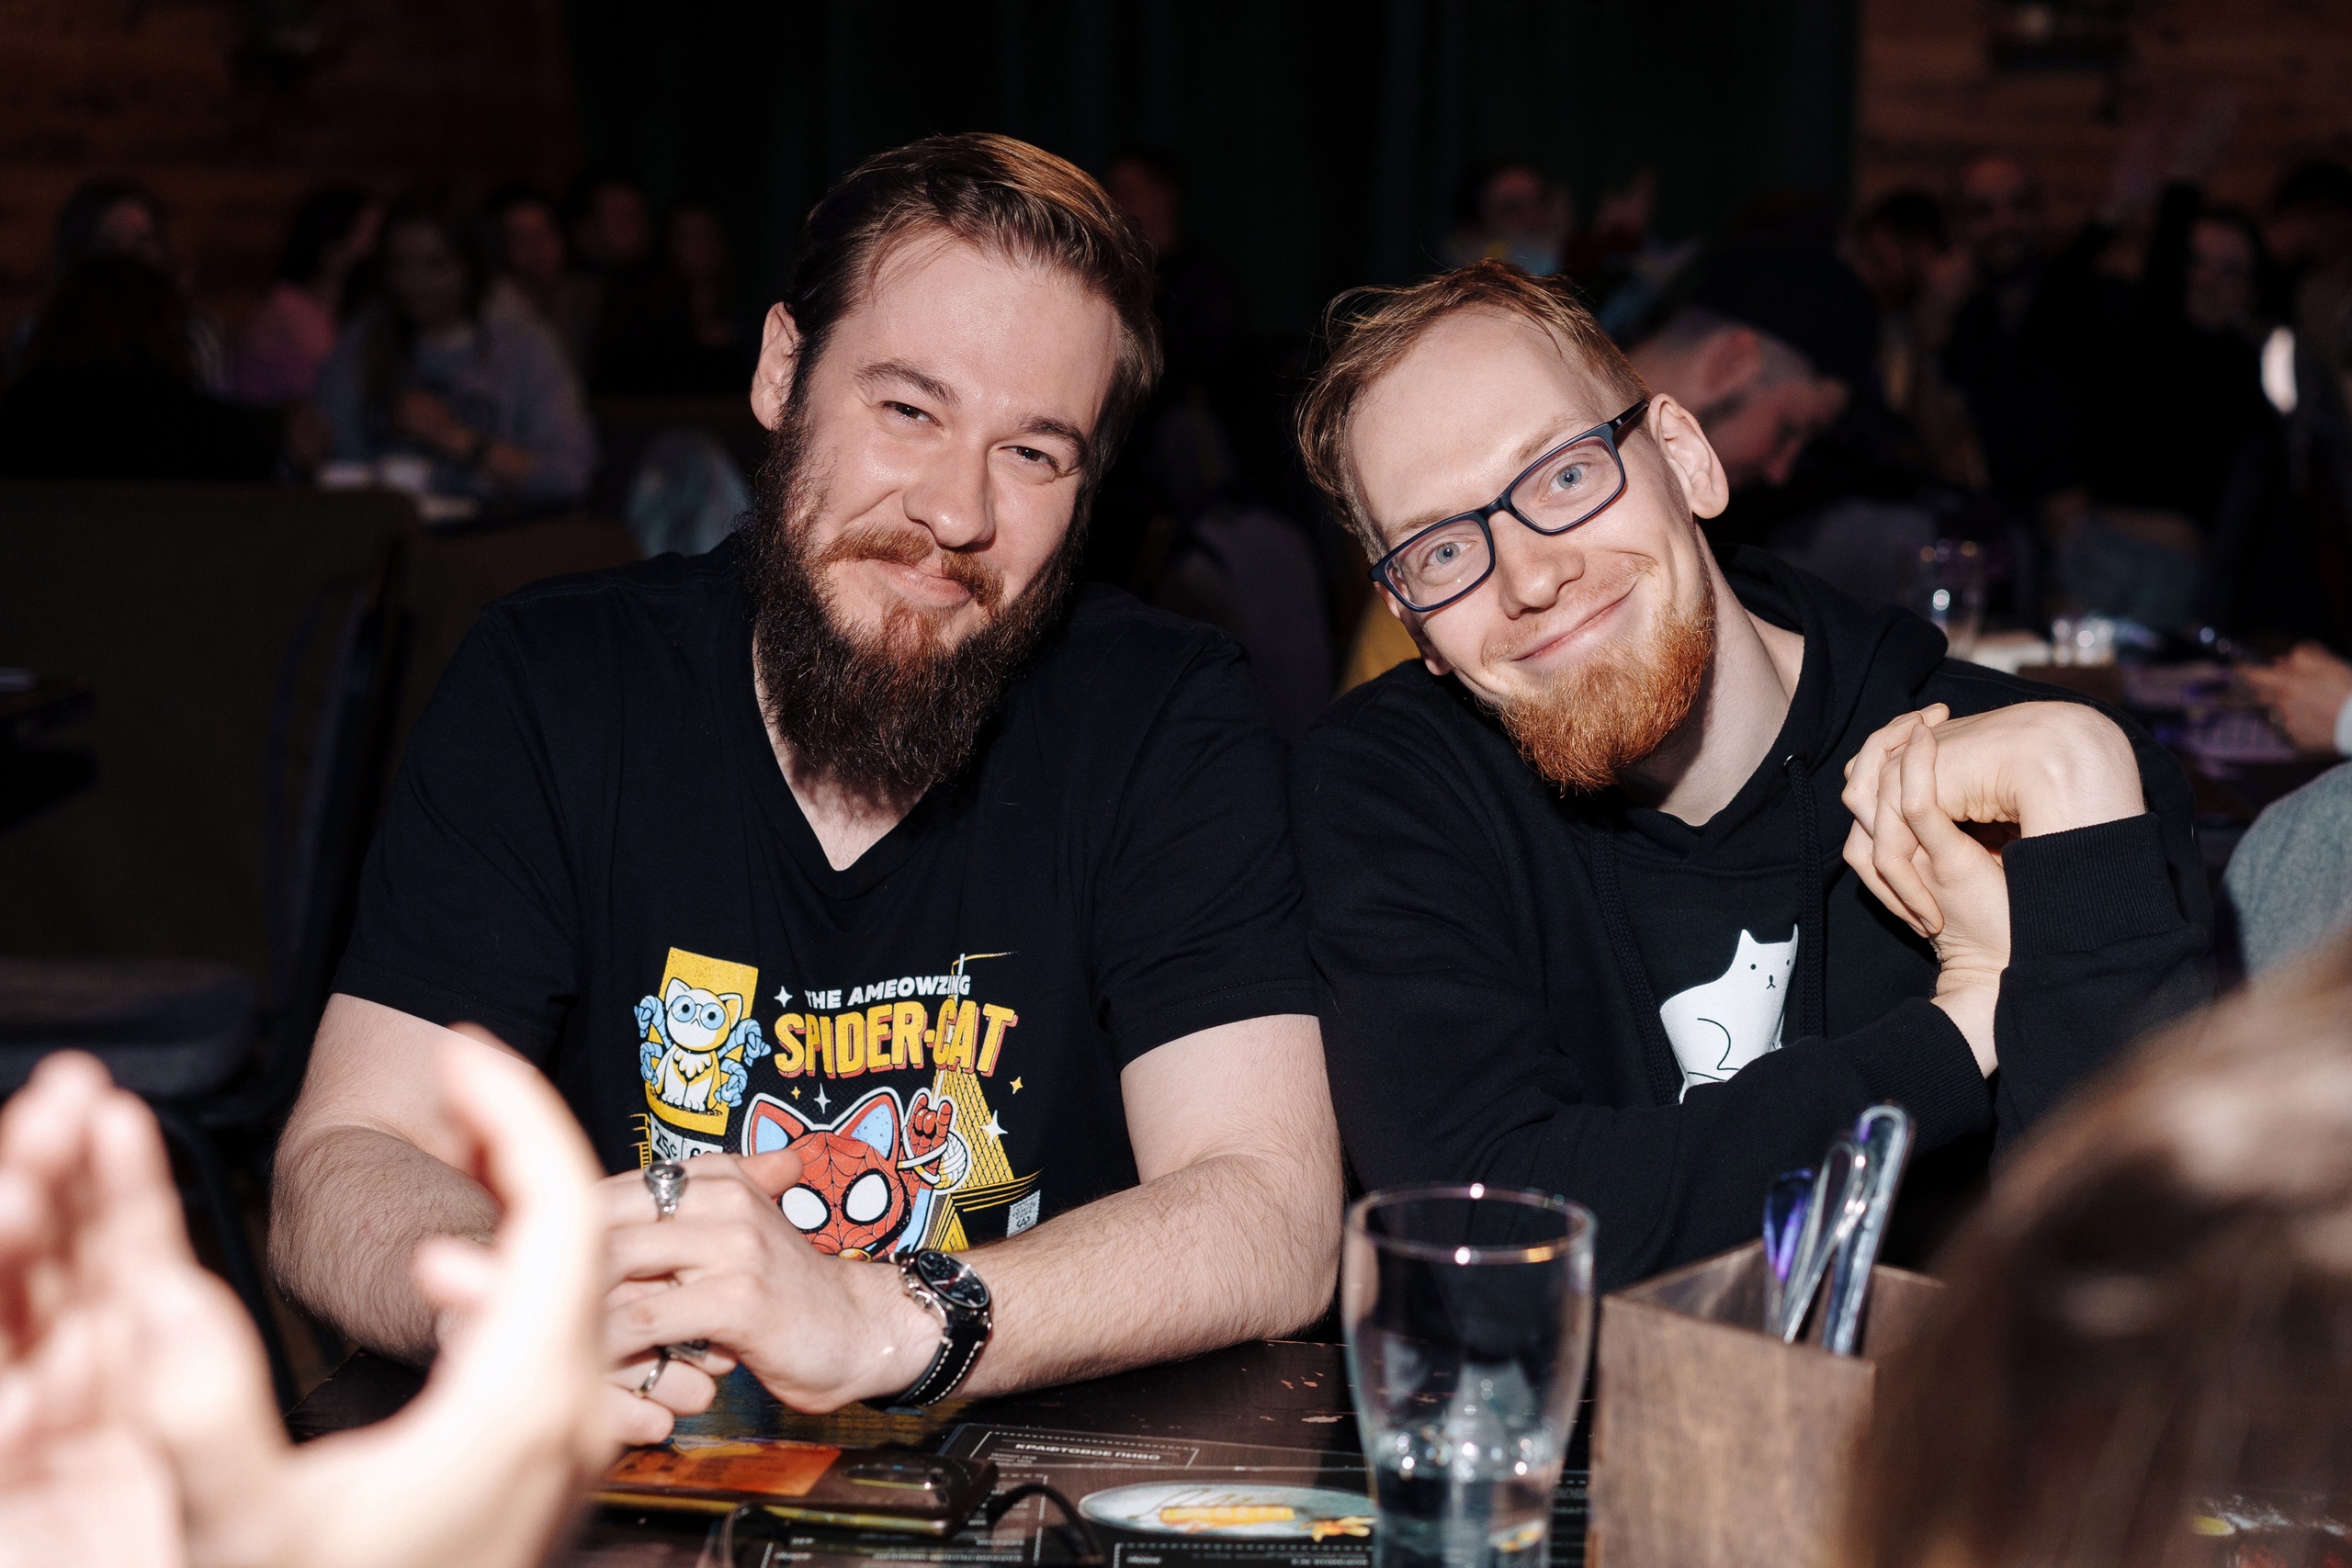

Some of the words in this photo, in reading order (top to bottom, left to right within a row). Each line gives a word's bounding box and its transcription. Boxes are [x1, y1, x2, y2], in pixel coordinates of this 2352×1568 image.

[805, 989, 842, 1010] THE
[847, 975, 971, 1007] AMEOWZING
[775, 998, 1019, 1080] SPIDER-CAT
[1015, 1443, 1113, 1457] КРАФТОВОЕ
[1114, 1450, 1160, 1461] ПИВО
